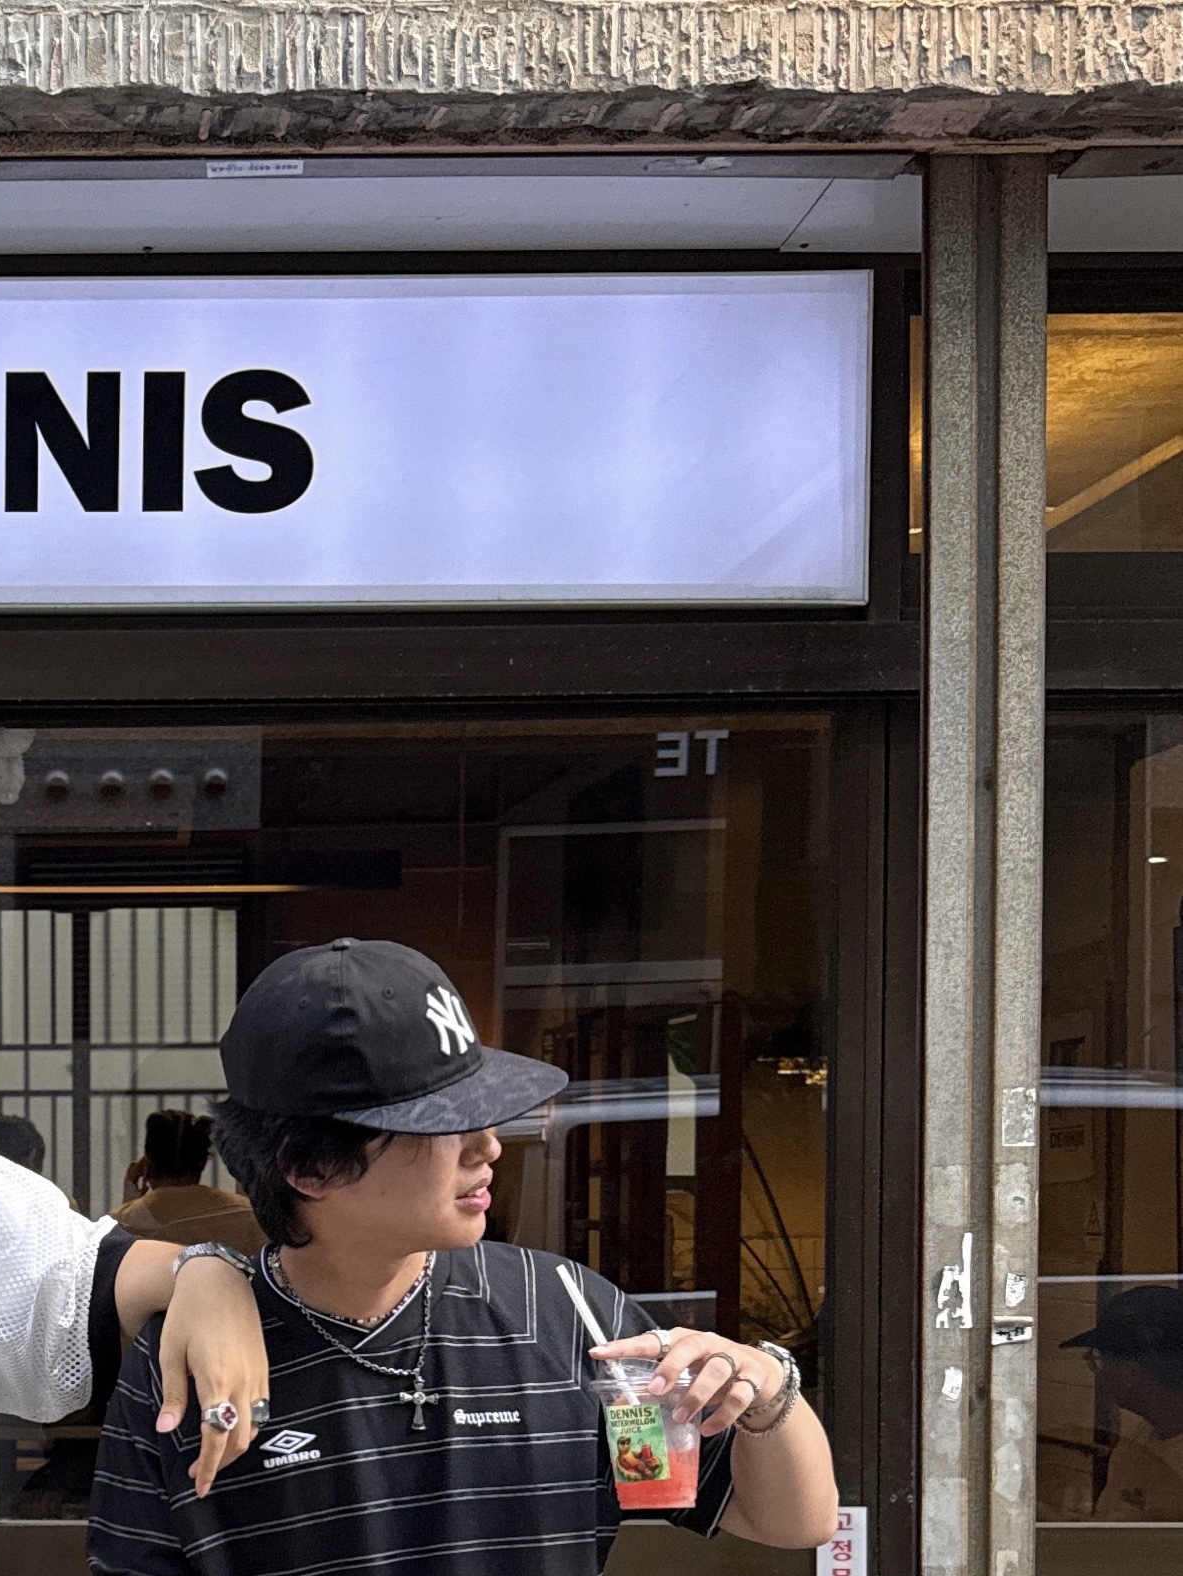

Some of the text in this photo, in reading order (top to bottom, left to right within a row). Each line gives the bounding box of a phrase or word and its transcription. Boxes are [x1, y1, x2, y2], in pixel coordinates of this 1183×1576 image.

[453, 1408, 521, 1427] Supreme
[609, 1406, 653, 1420] DENNIS
[619, 1426, 642, 1435] JUICE
[263, 1449, 321, 1469] UMBRO
